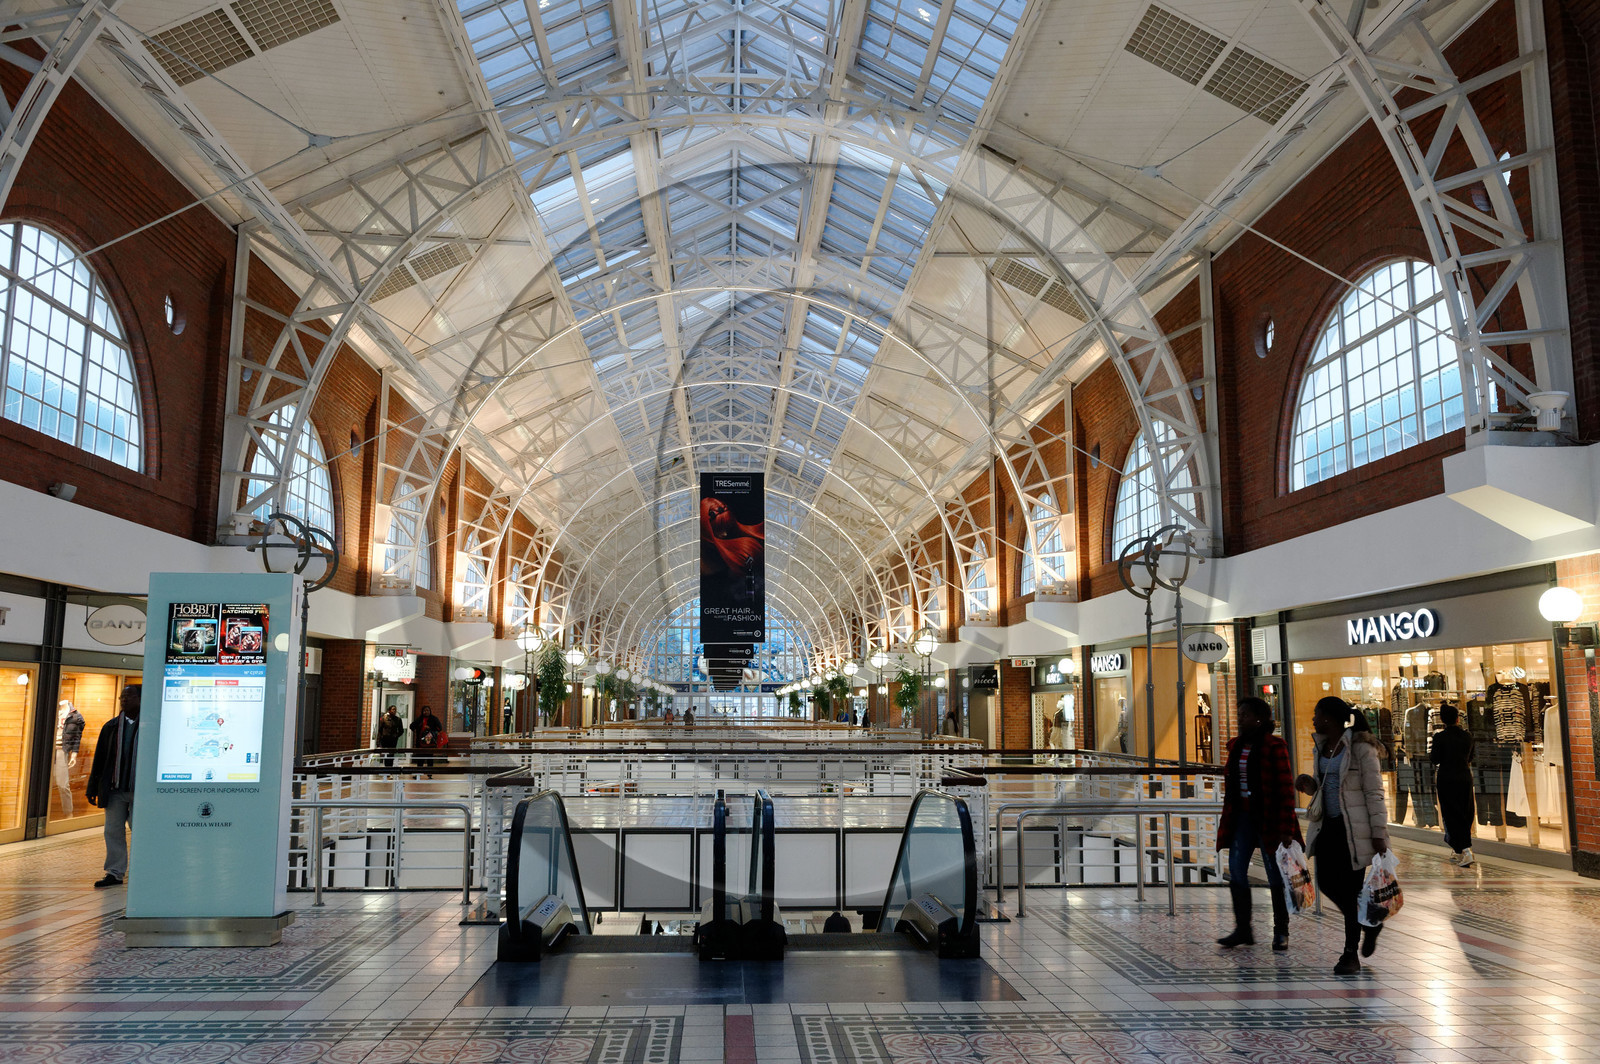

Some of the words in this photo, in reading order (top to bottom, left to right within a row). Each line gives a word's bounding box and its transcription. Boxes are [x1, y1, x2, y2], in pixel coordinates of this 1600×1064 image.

[172, 603, 218, 618] HOBBIT
[90, 620, 146, 629] GANT
[1347, 608, 1436, 645] MANGO
[1188, 642, 1223, 652] MANGO
[1091, 653, 1121, 672] MANGO
